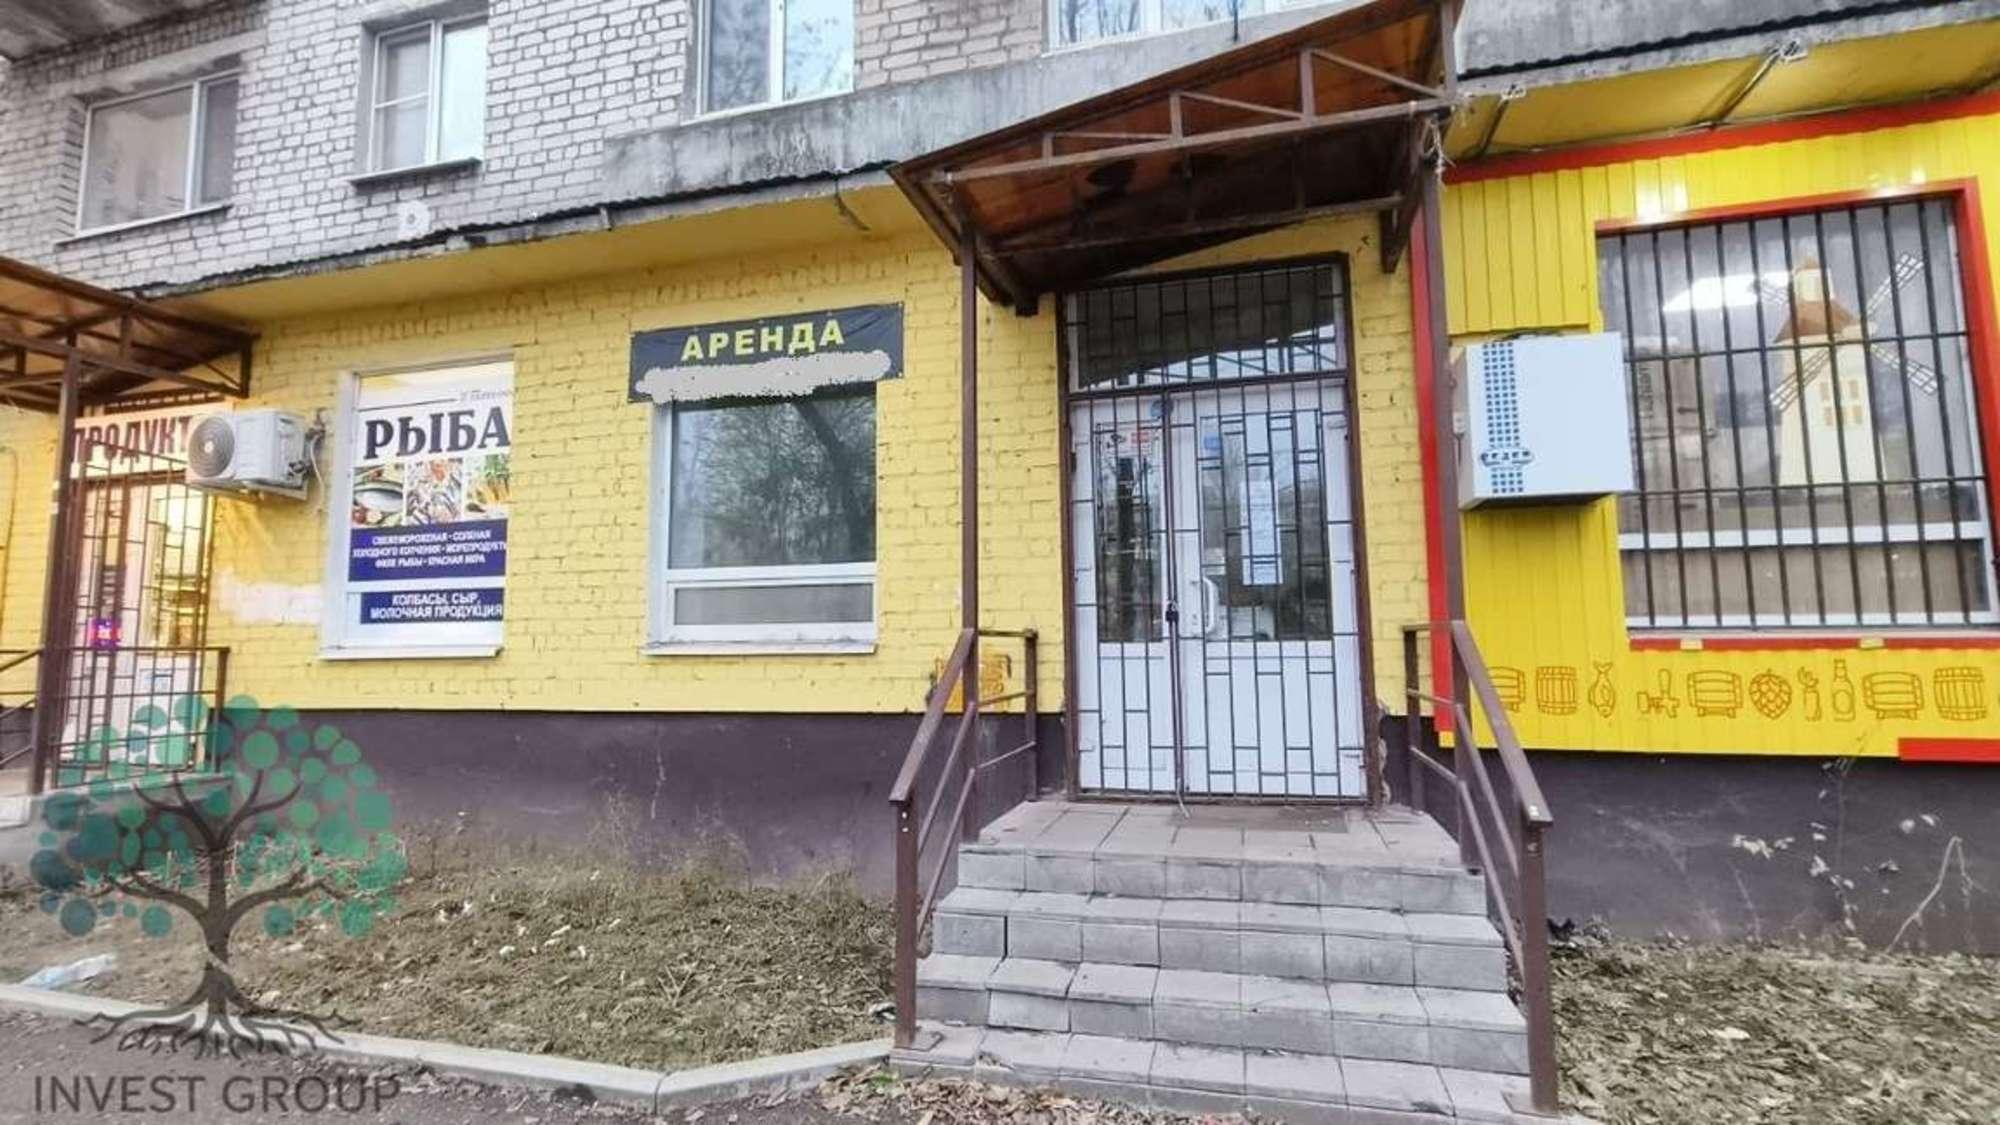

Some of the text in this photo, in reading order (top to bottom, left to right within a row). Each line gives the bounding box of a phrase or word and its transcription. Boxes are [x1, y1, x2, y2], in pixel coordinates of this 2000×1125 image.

[681, 319, 845, 362] АРЕНДА
[73, 415, 191, 464] ПРОДУКТ
[363, 406, 511, 460] РЫБА
[370, 604, 503, 619] МОЛОЧНАЯ ПРОДУКЦИЯ
[392, 594, 448, 606] КОЛБАСЫ,
